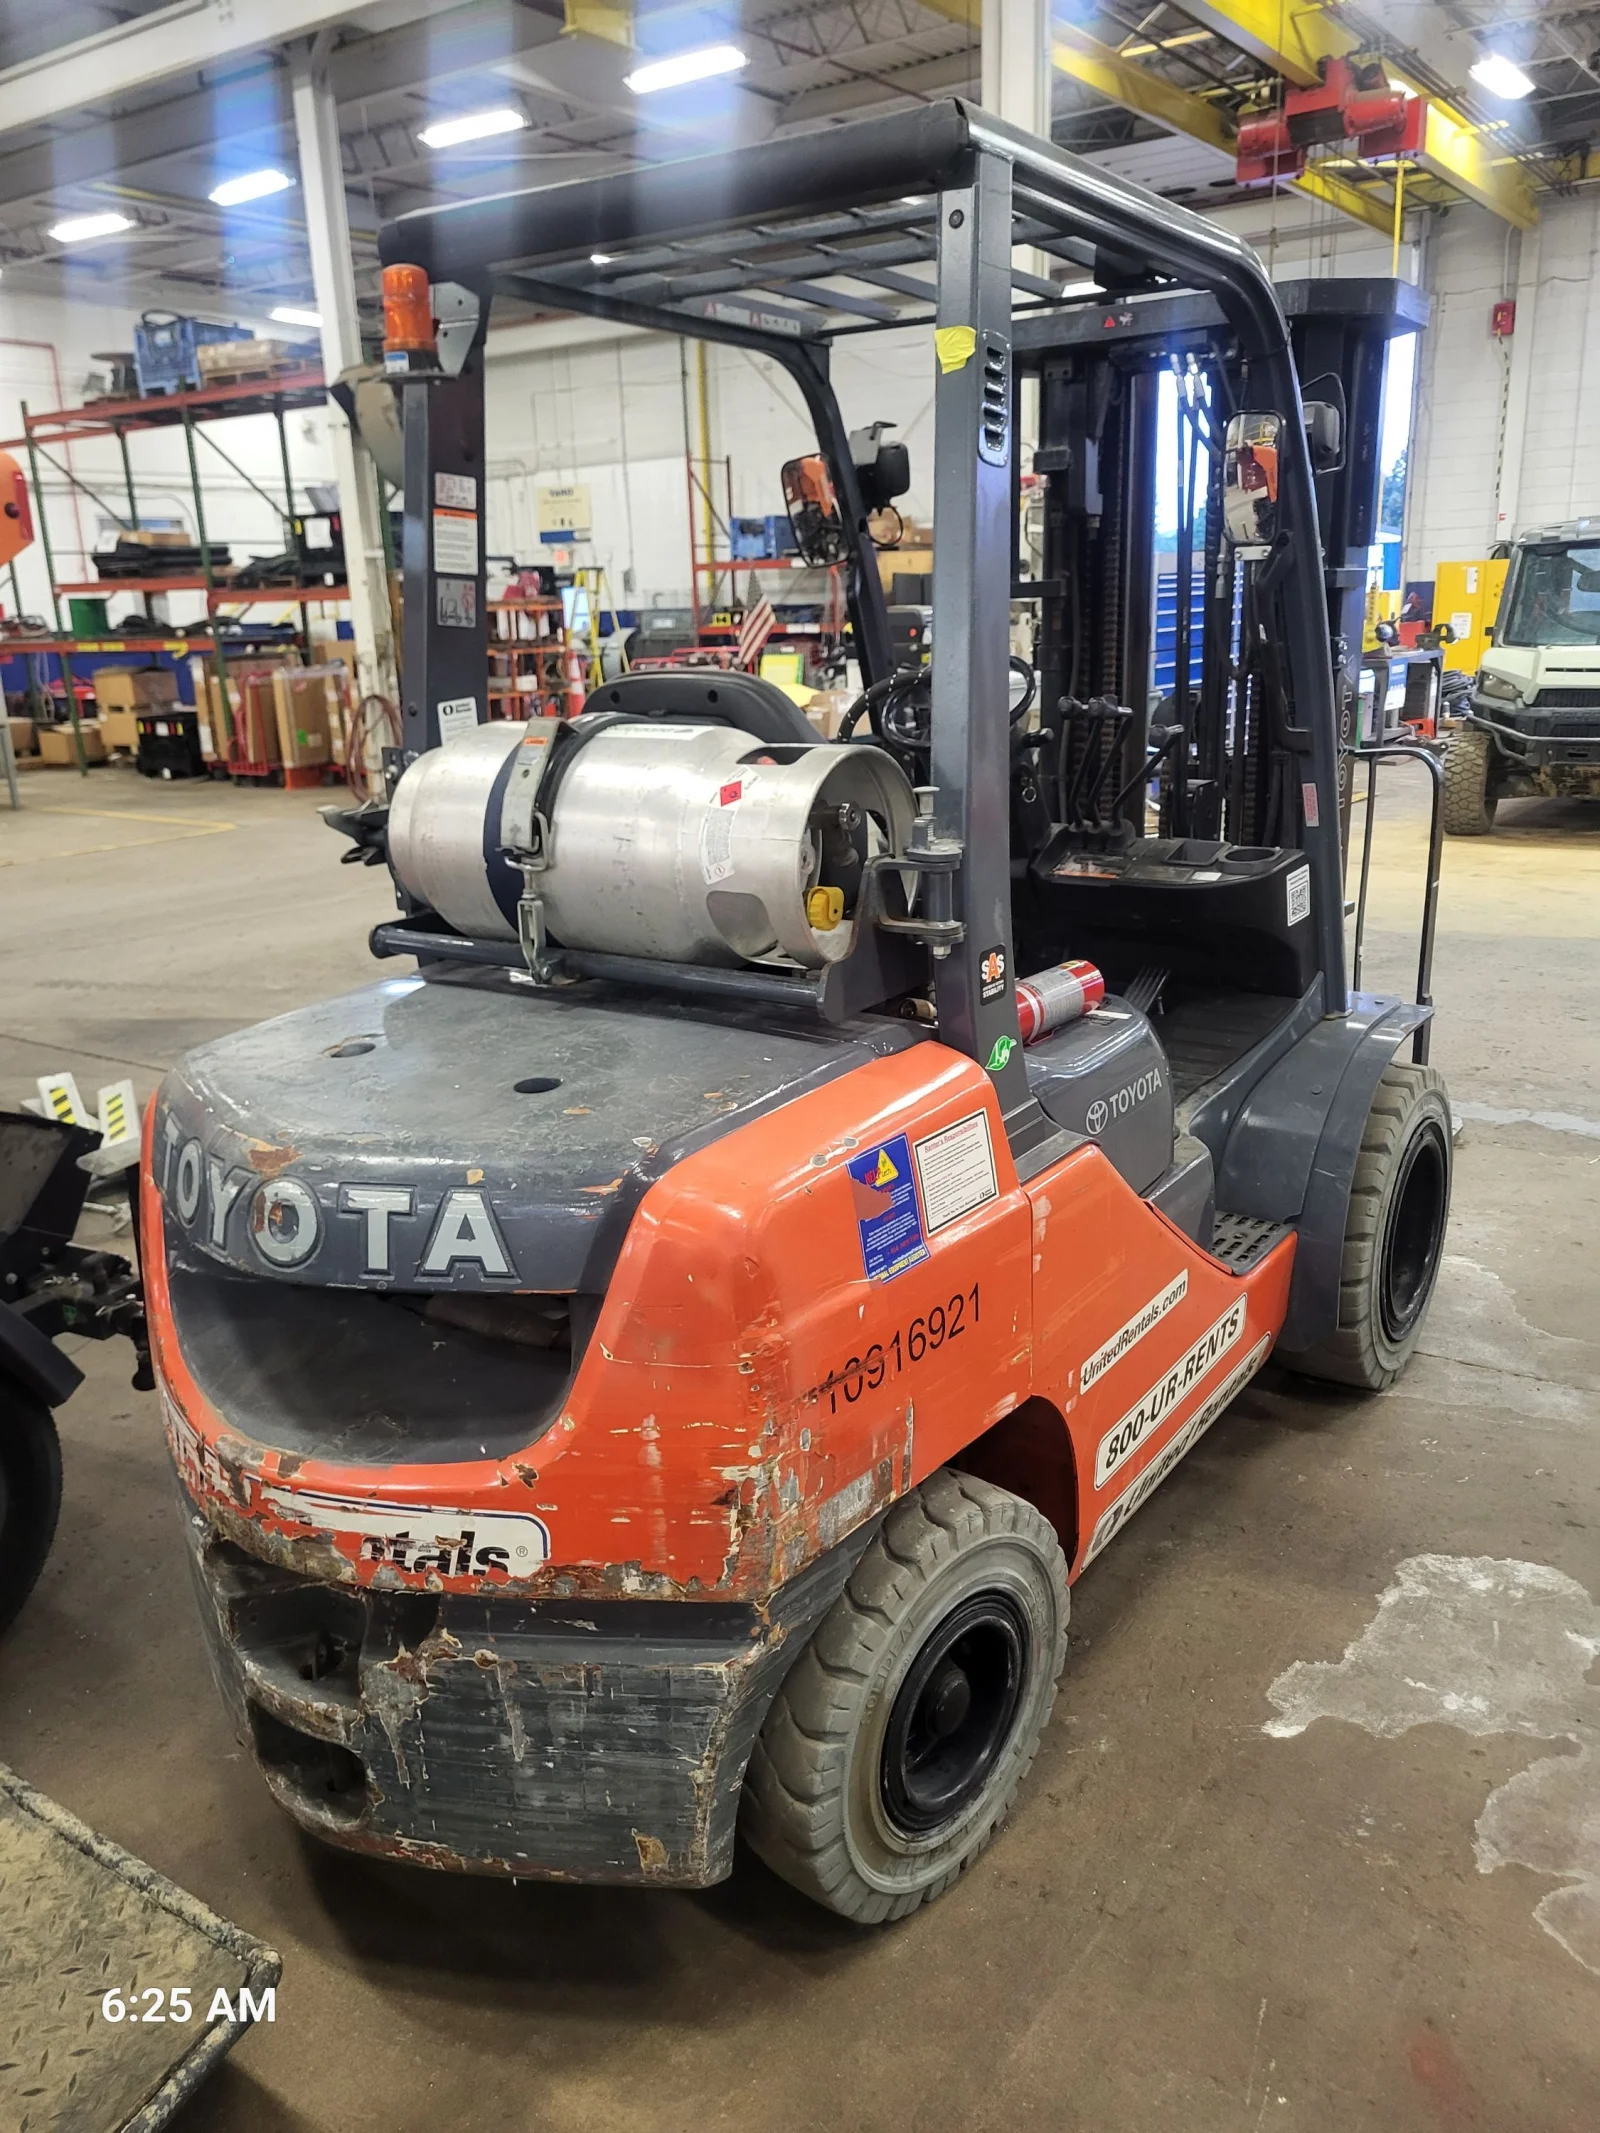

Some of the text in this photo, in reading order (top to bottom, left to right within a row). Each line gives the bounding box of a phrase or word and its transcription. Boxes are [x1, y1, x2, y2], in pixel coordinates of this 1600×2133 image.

[981, 952, 1005, 983] SAS
[1109, 1067, 1162, 1118] TOYOTA
[162, 1110, 518, 1281] TOYOTA
[826, 1282, 979, 1414] 10916921
[1083, 1279, 1186, 1386] UnitedRentals.com
[1106, 1307, 1239, 1469] 800-UR-RENTS
[1124, 1422, 1198, 1517] United
